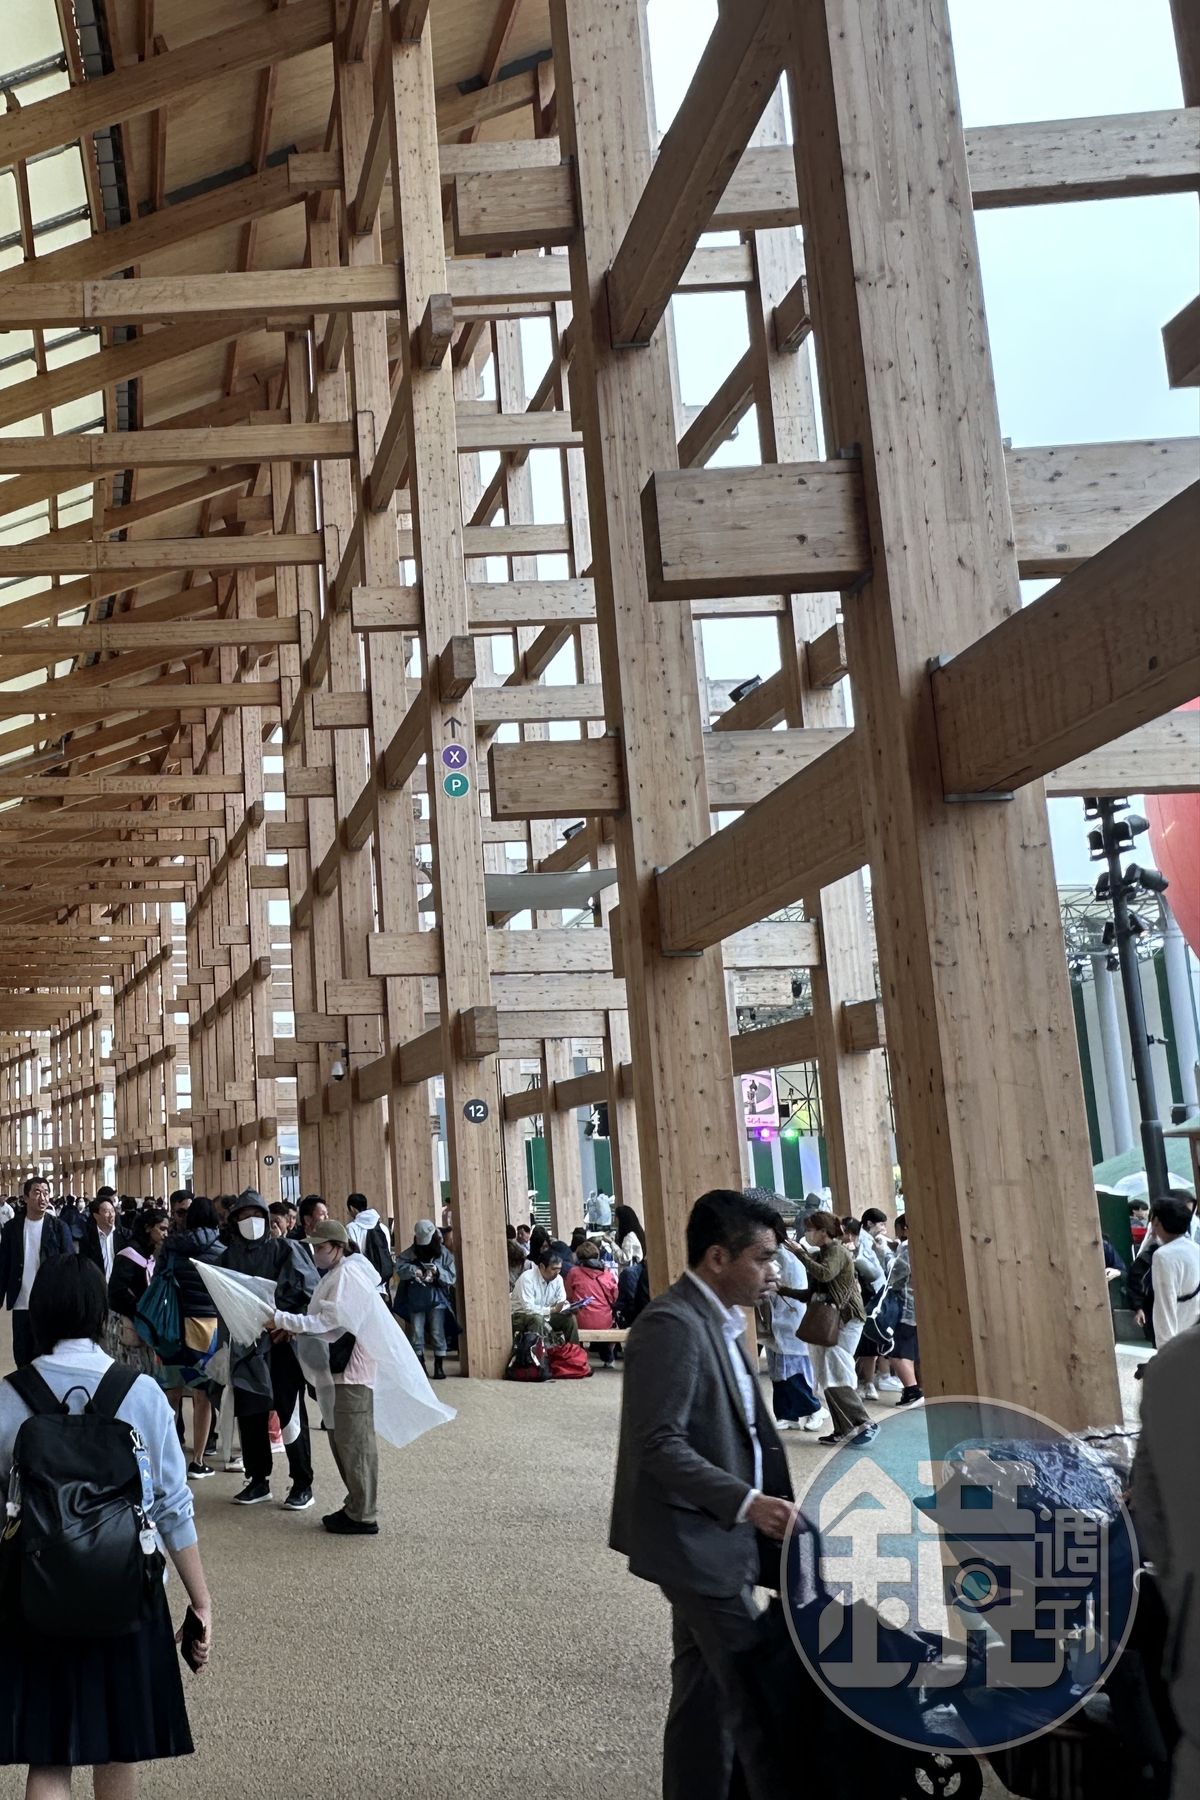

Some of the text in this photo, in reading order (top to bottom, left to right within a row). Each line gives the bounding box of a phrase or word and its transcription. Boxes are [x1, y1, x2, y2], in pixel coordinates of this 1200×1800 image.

[449, 750, 461, 764] X
[451, 779, 462, 791] P
[468, 1105, 485, 1118] 12
